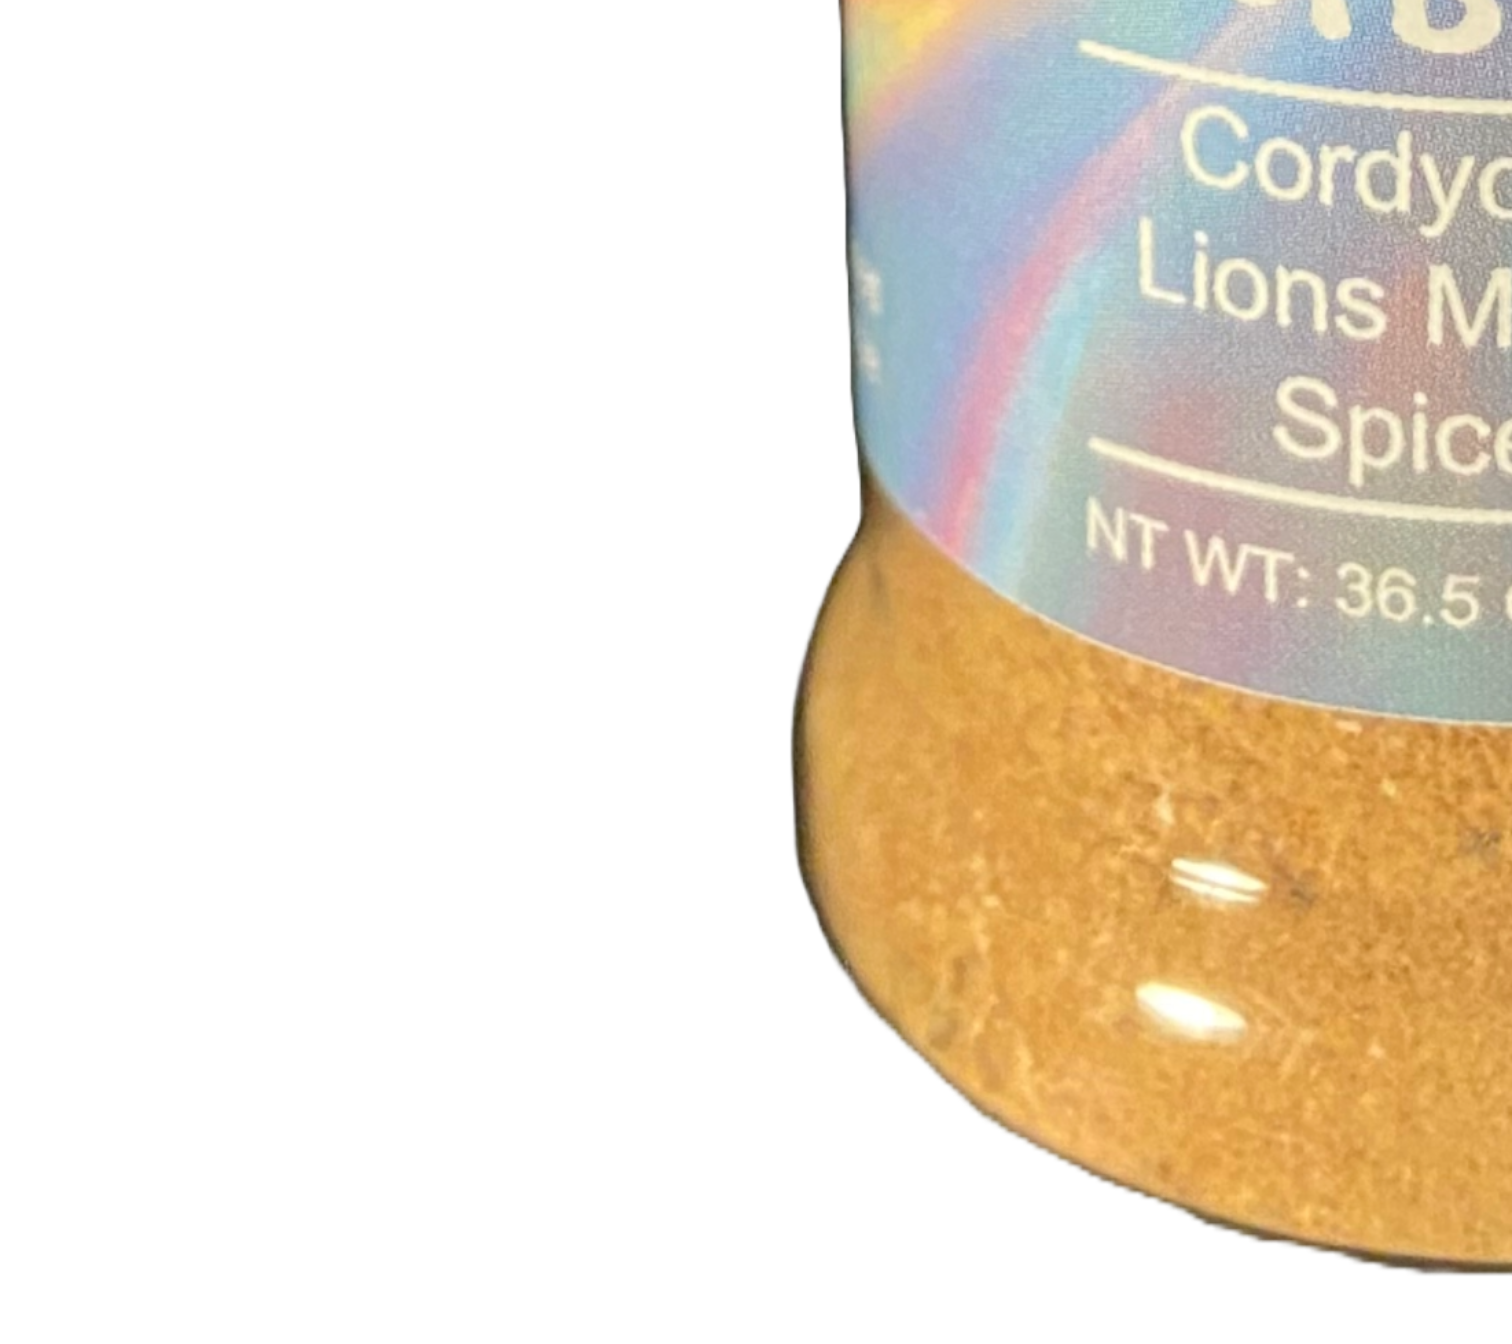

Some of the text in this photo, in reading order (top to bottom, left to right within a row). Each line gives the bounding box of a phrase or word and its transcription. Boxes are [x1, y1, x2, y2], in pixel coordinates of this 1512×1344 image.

[1138, 216, 1388, 342] Lions
[1084, 498, 1168, 572] NT
[1184, 530, 1311, 611] WT:
[1336, 562, 1481, 627] 36.5
